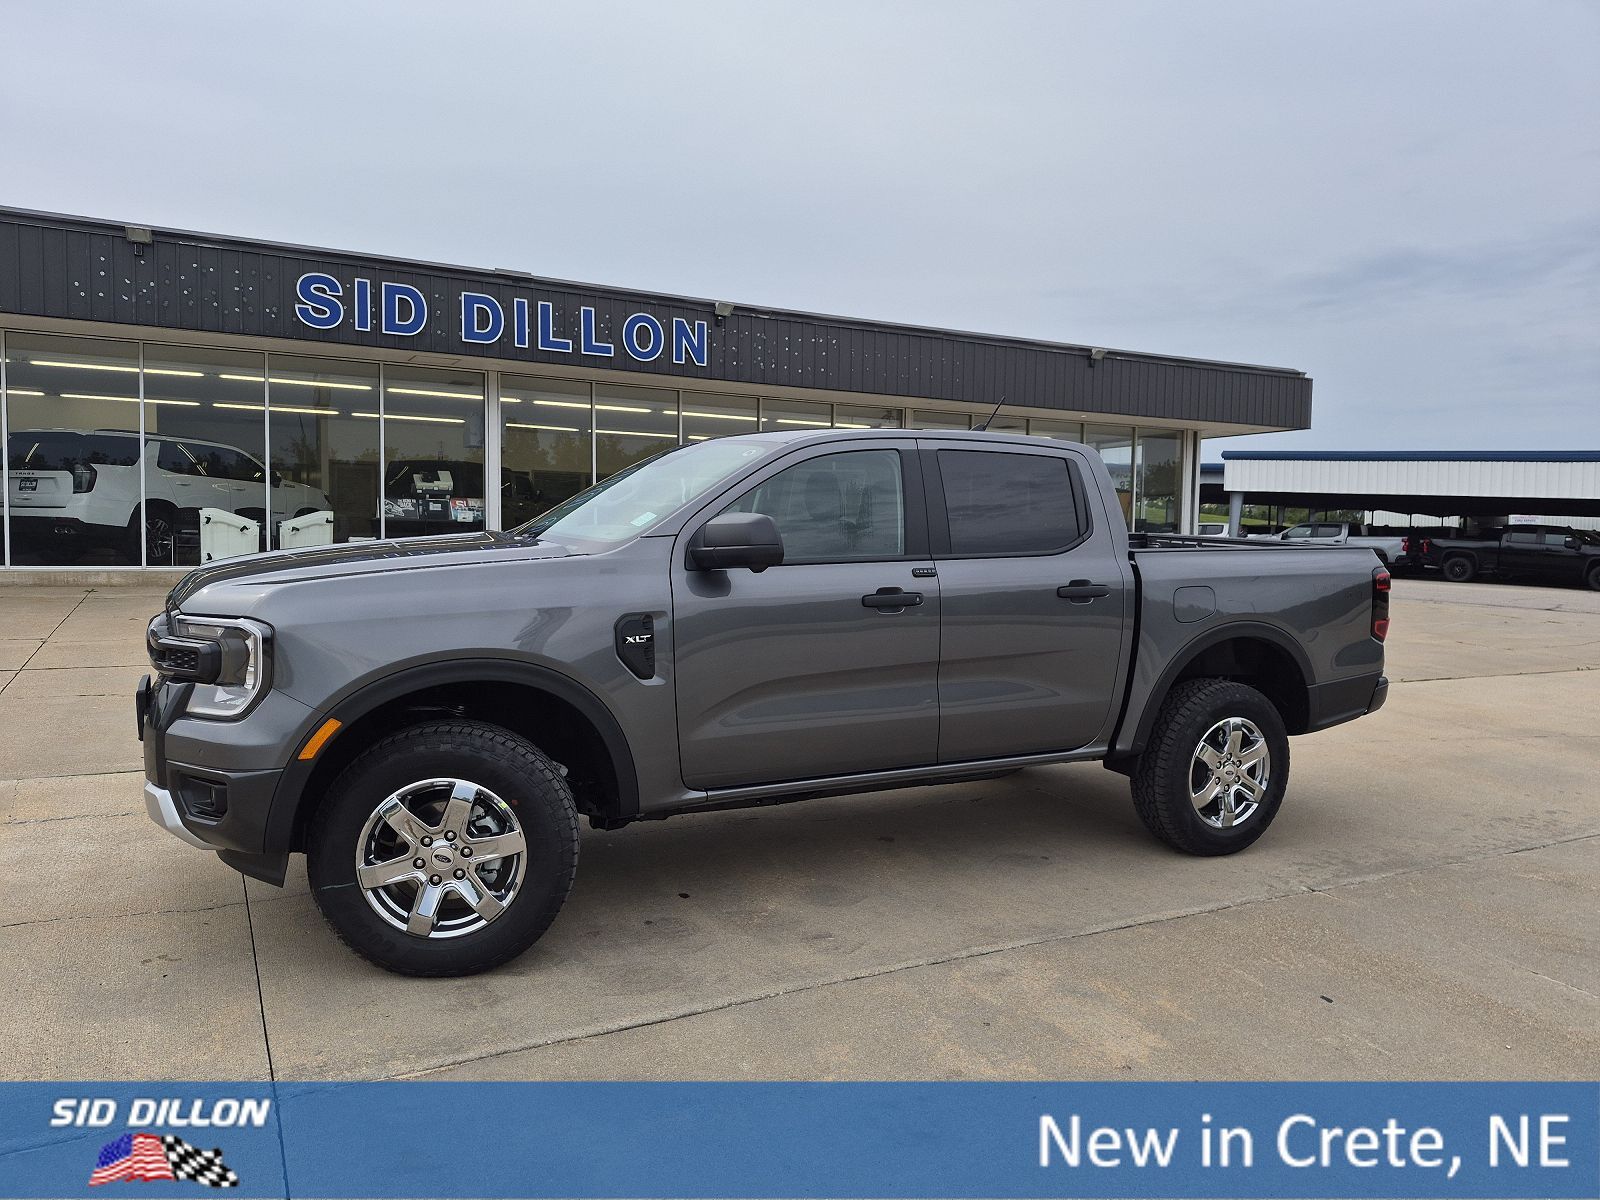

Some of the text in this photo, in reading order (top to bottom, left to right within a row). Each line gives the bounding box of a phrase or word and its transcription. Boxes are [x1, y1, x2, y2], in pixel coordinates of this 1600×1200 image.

[294, 272, 708, 367] SID DILLON
[625, 634, 651, 643] XLT
